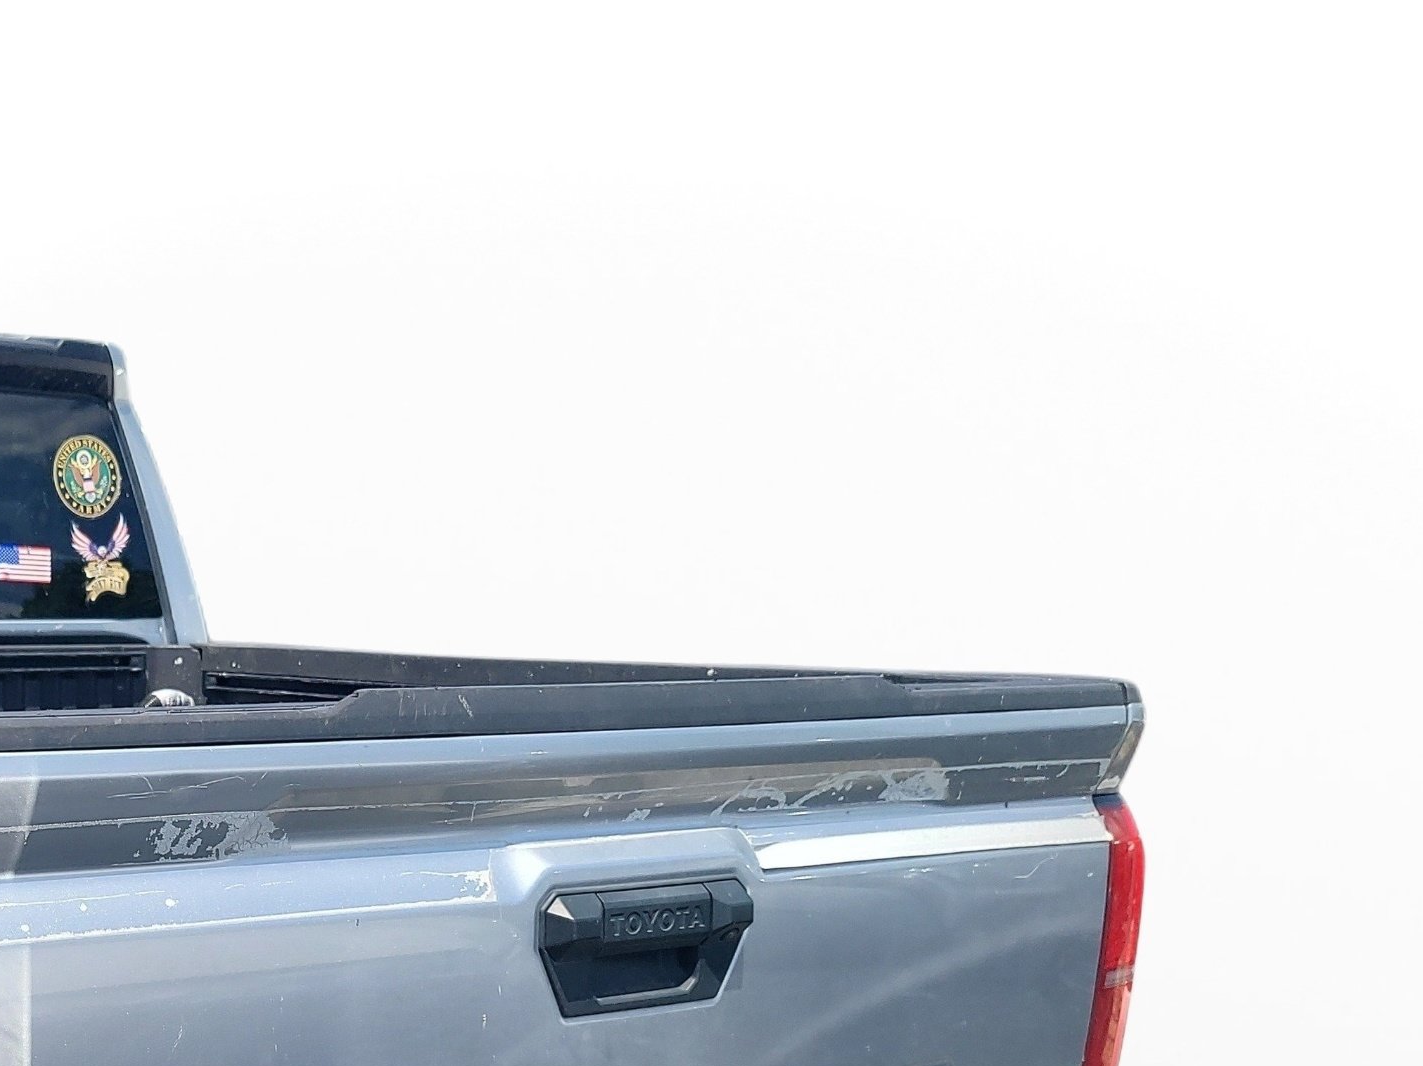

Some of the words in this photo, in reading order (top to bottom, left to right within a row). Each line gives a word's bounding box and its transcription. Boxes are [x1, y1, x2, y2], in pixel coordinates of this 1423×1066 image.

[58, 440, 82, 468] UNITED
[83, 440, 111, 462] STATES
[79, 500, 106, 514] ARMY
[609, 905, 705, 937] TOYOTA
